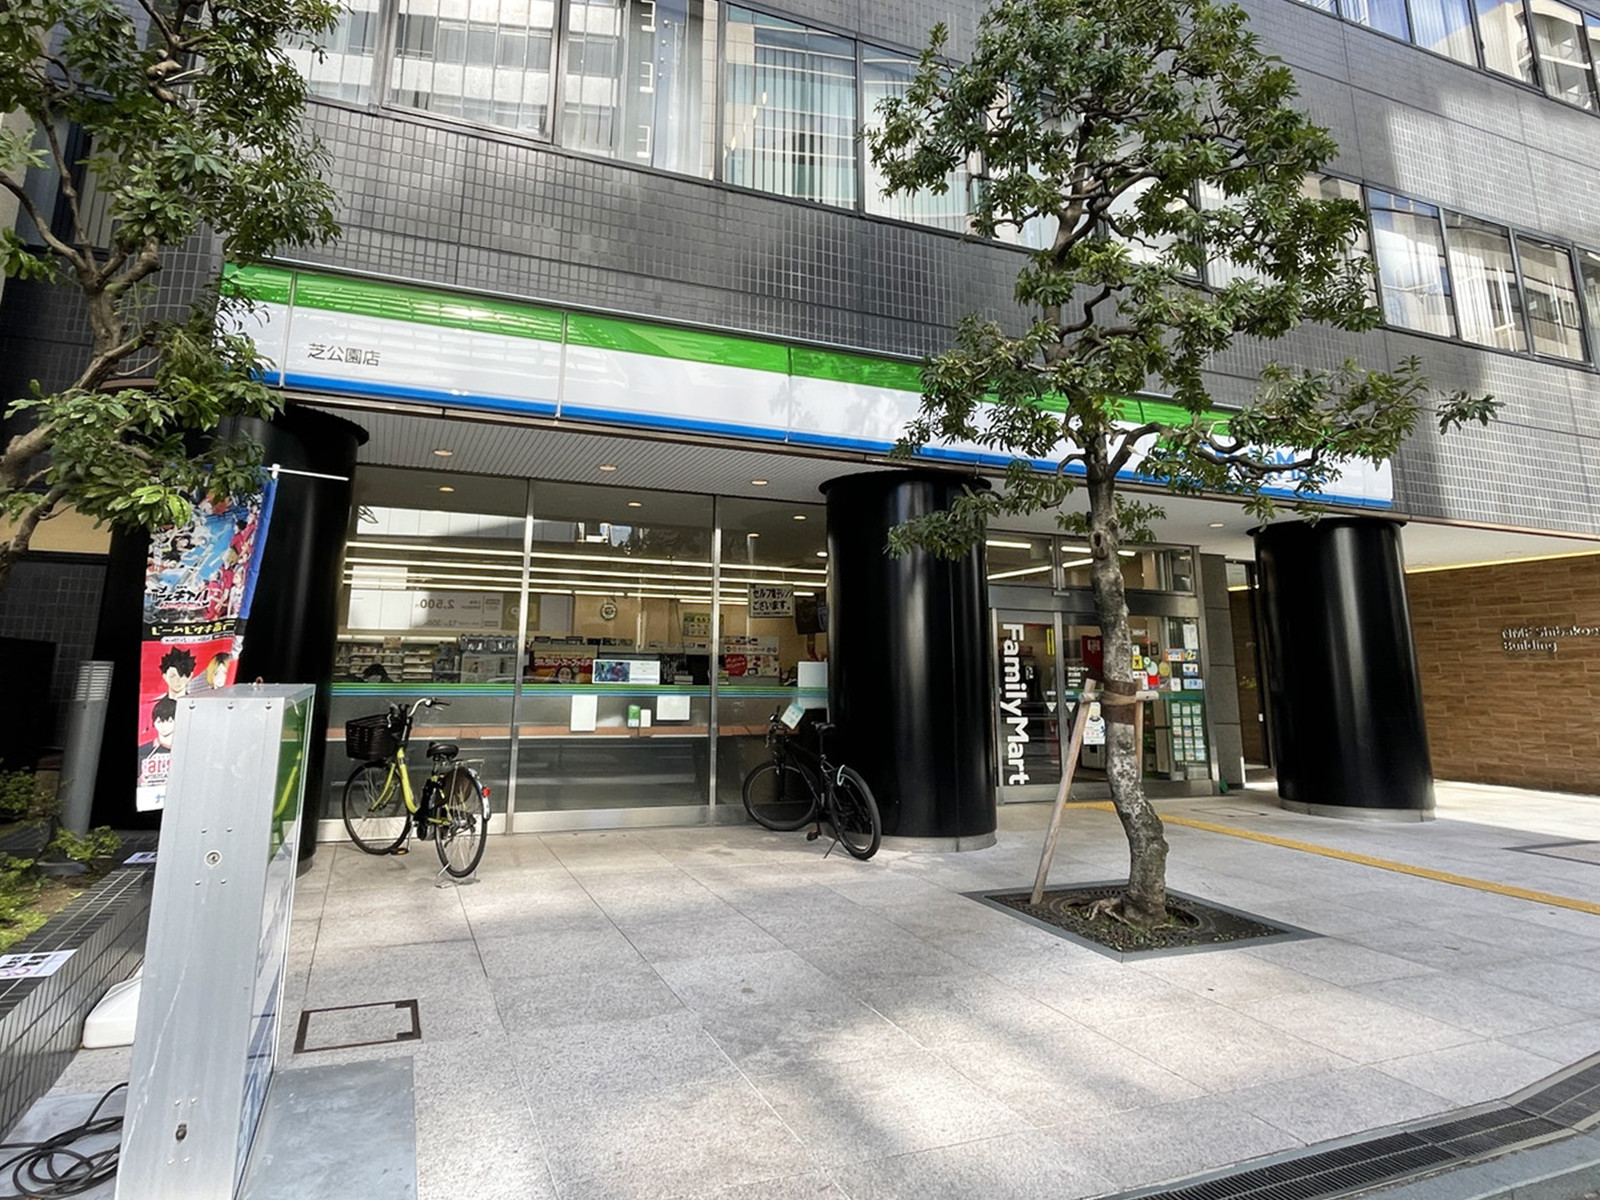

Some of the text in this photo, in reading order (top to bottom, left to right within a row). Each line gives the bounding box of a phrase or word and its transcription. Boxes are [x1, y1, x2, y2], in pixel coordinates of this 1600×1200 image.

[308, 342, 381, 366] 芝公園店
[1000, 623, 1030, 785] FamilyMart
